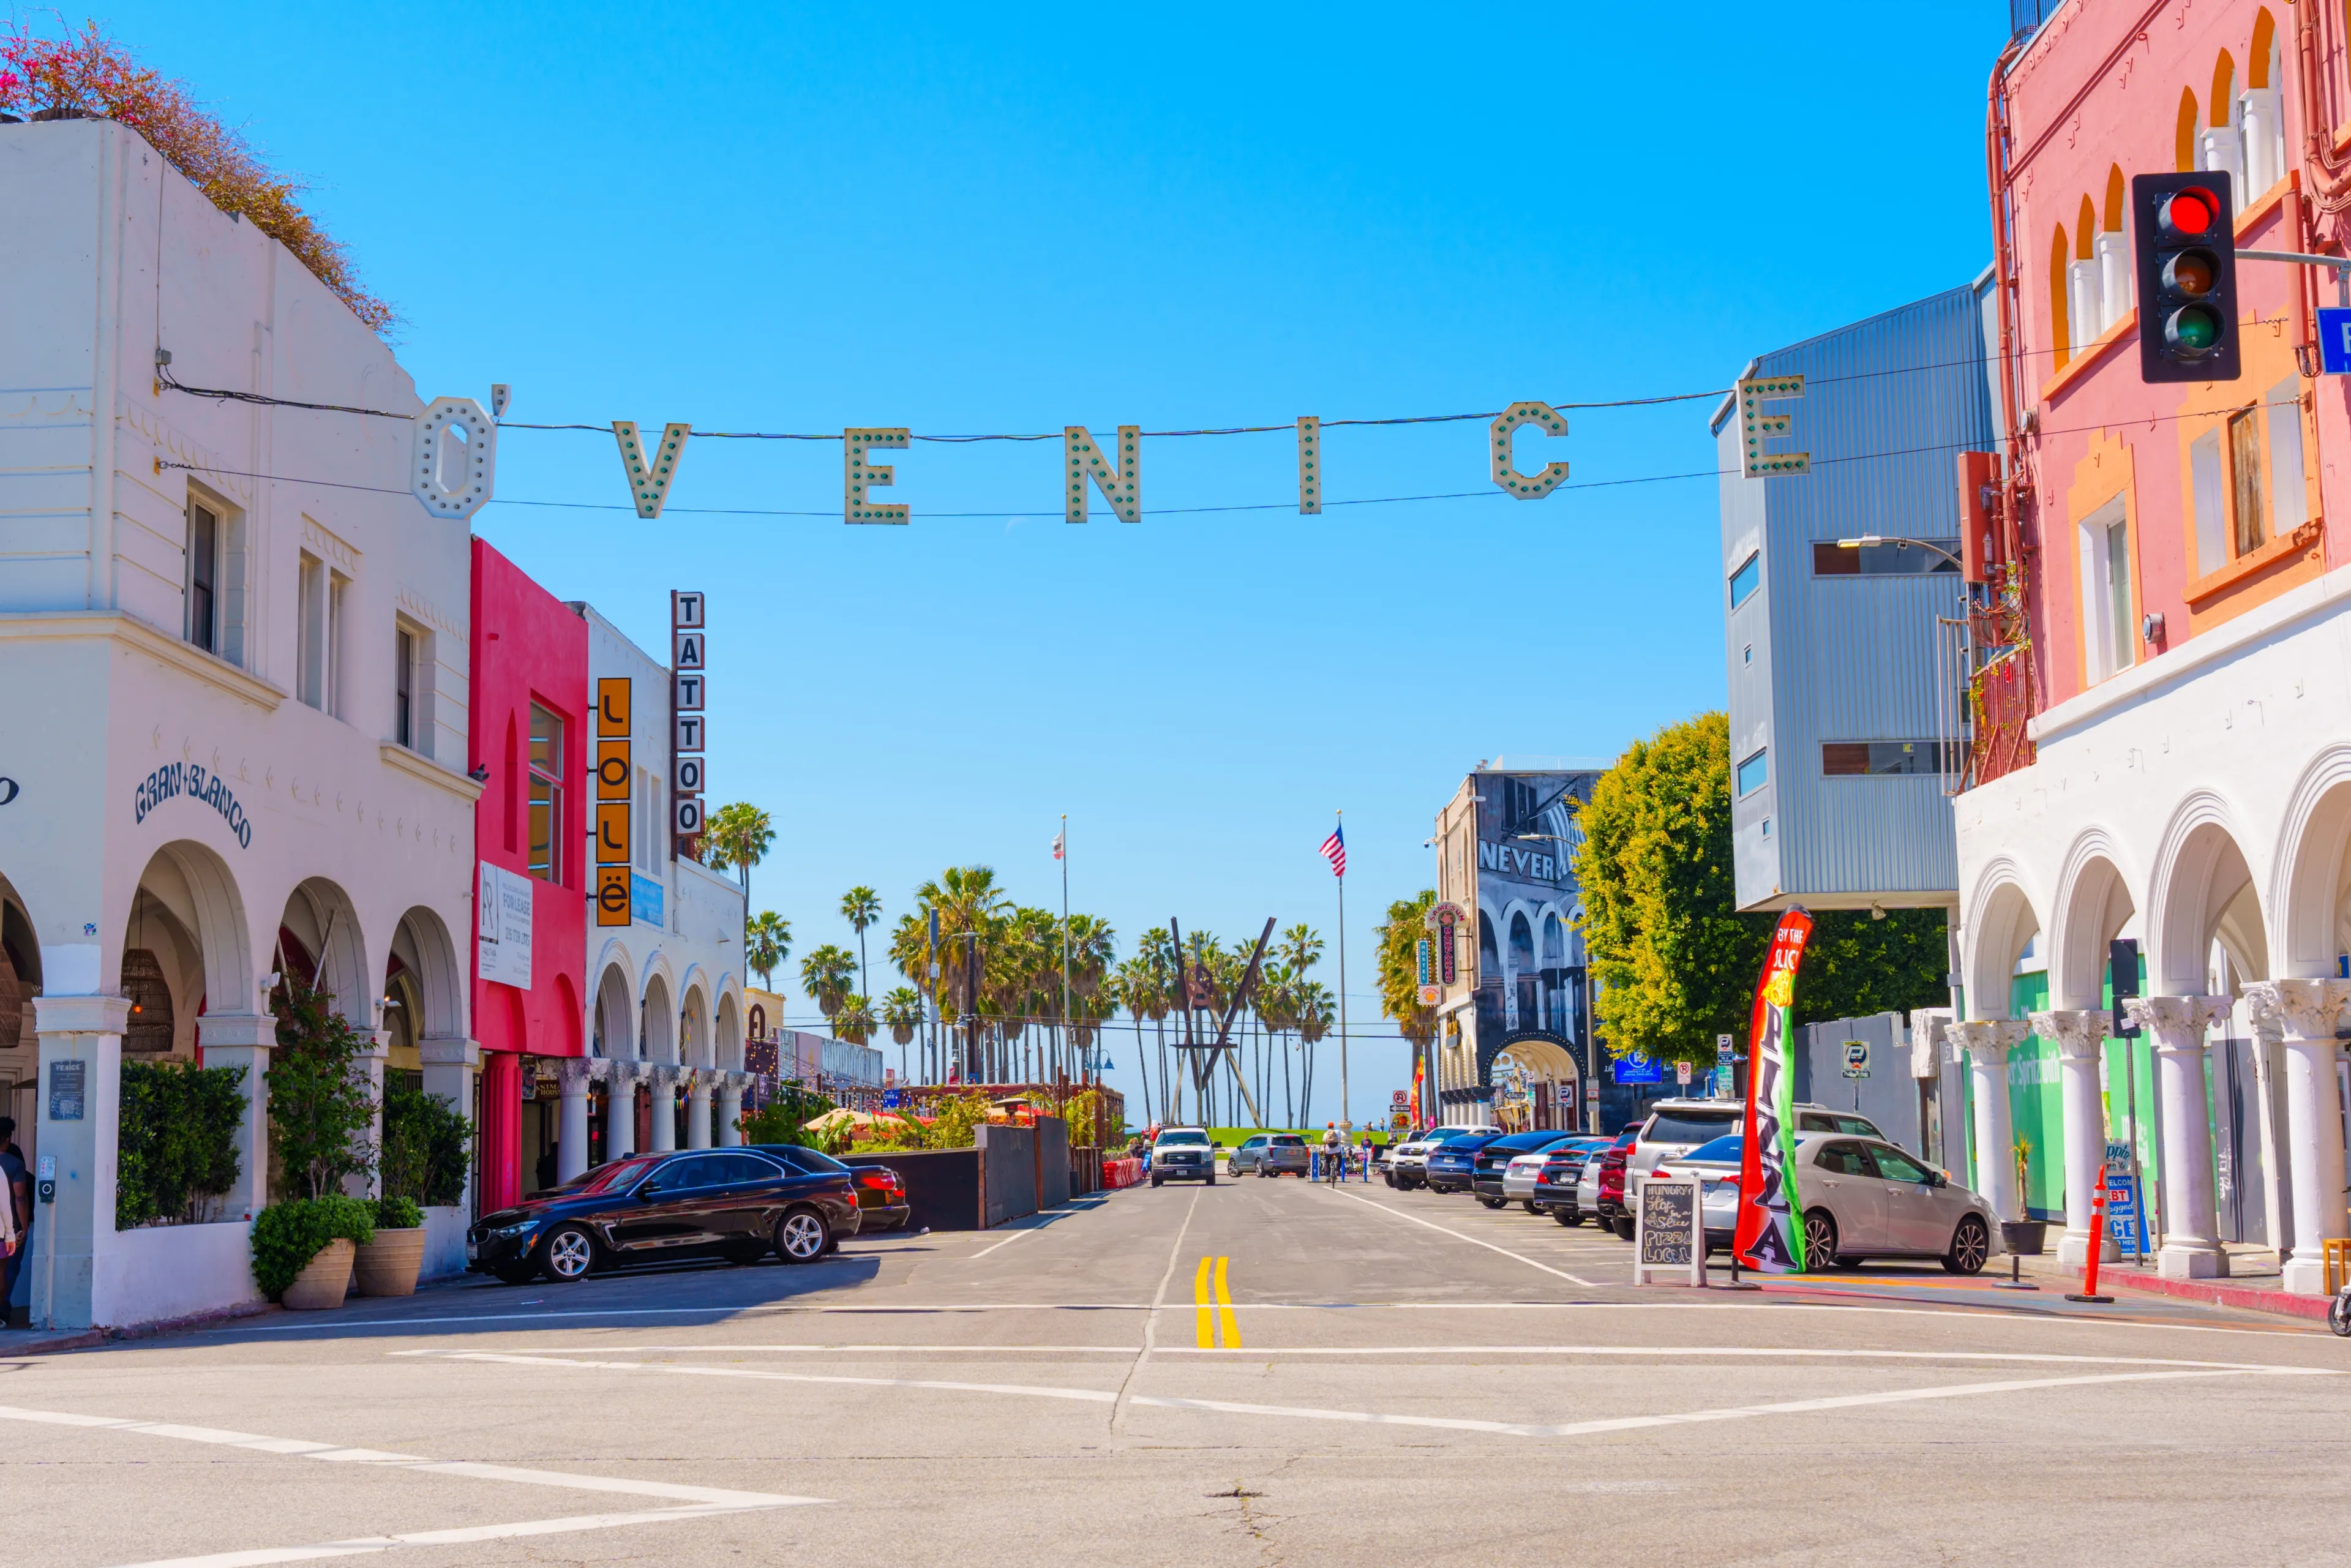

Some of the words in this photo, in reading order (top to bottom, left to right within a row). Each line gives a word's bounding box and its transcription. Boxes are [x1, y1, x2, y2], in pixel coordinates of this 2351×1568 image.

[679, 597, 698, 829] TATTOO
[135, 762, 182, 825] GRAN
[188, 764, 251, 849] BLANCO
[1479, 839, 1554, 881] NEVER
[503, 892, 514, 910] FOR
[514, 897, 530, 917] LEASE
[1430, 904, 1465, 922] SAMESUN
[1778, 928, 1788, 942] BY
[1790, 929, 1804, 943] THE
[1444, 928, 1452, 983] BACKPACKERS
[1945, 1046, 1951, 1059] 57
[2017, 1052, 2040, 1092] Spritz
[2042, 1050, 2060, 1084] with
[1743, 1000, 1799, 1269] PIZZA
[2106, 1144, 2131, 1161] ppin
[1647, 1185, 1693, 1195] HUNGRY?
[1646, 1196, 1676, 1214] Stop
[2109, 1201, 2134, 1214] agged
[1658, 1217, 1690, 1229] Slice
[2110, 1219, 2135, 1237] CE
[1644, 1231, 1692, 1247] PIZZA
[1644, 1247, 1692, 1263] LOCAL
